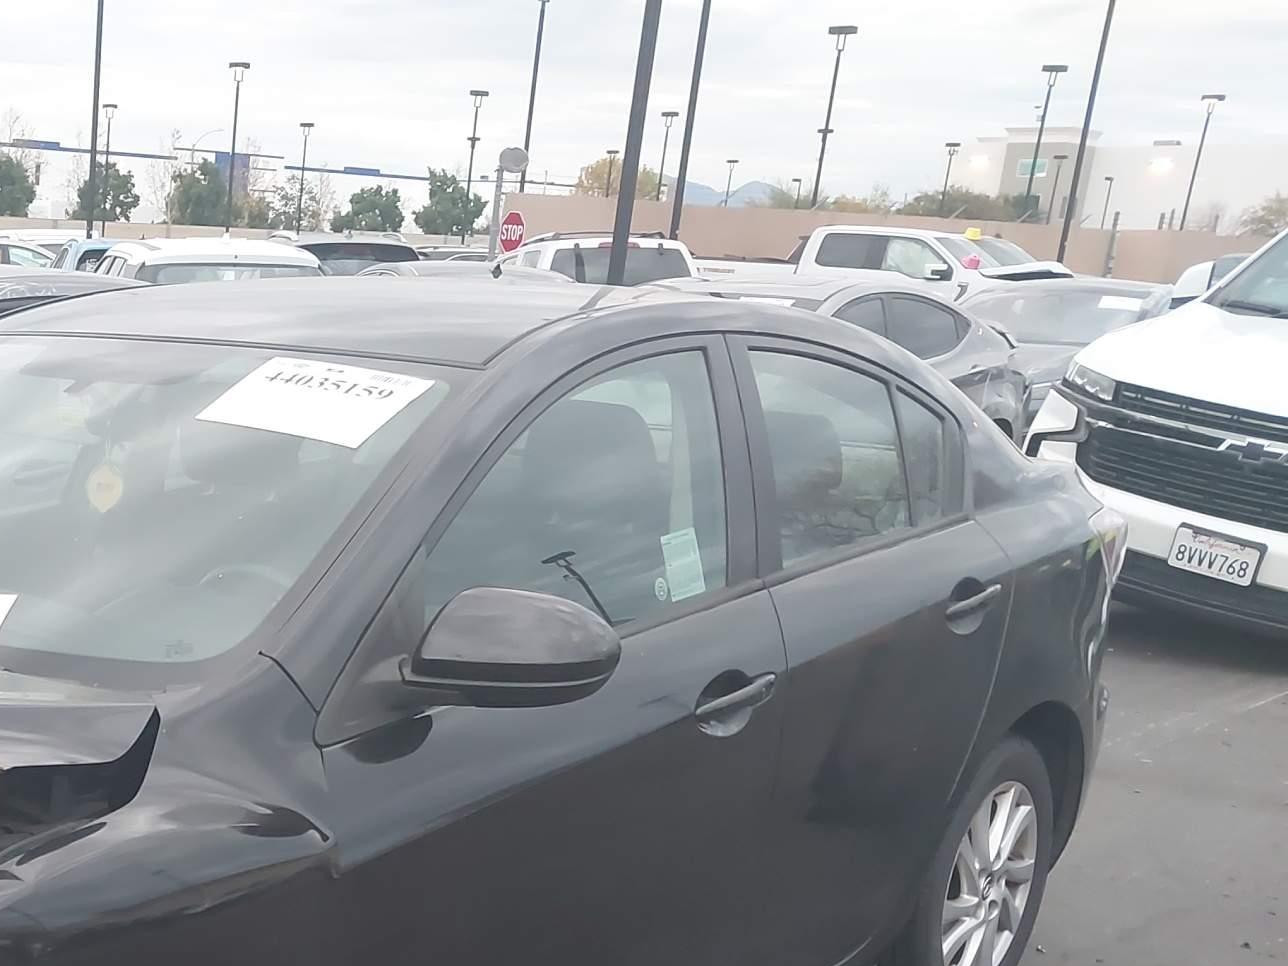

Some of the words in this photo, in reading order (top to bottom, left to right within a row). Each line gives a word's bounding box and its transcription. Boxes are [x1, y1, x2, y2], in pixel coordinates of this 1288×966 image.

[501, 224, 524, 241] STOP
[265, 370, 394, 400] 44035159
[1175, 543, 1250, 579] 8VVV768
